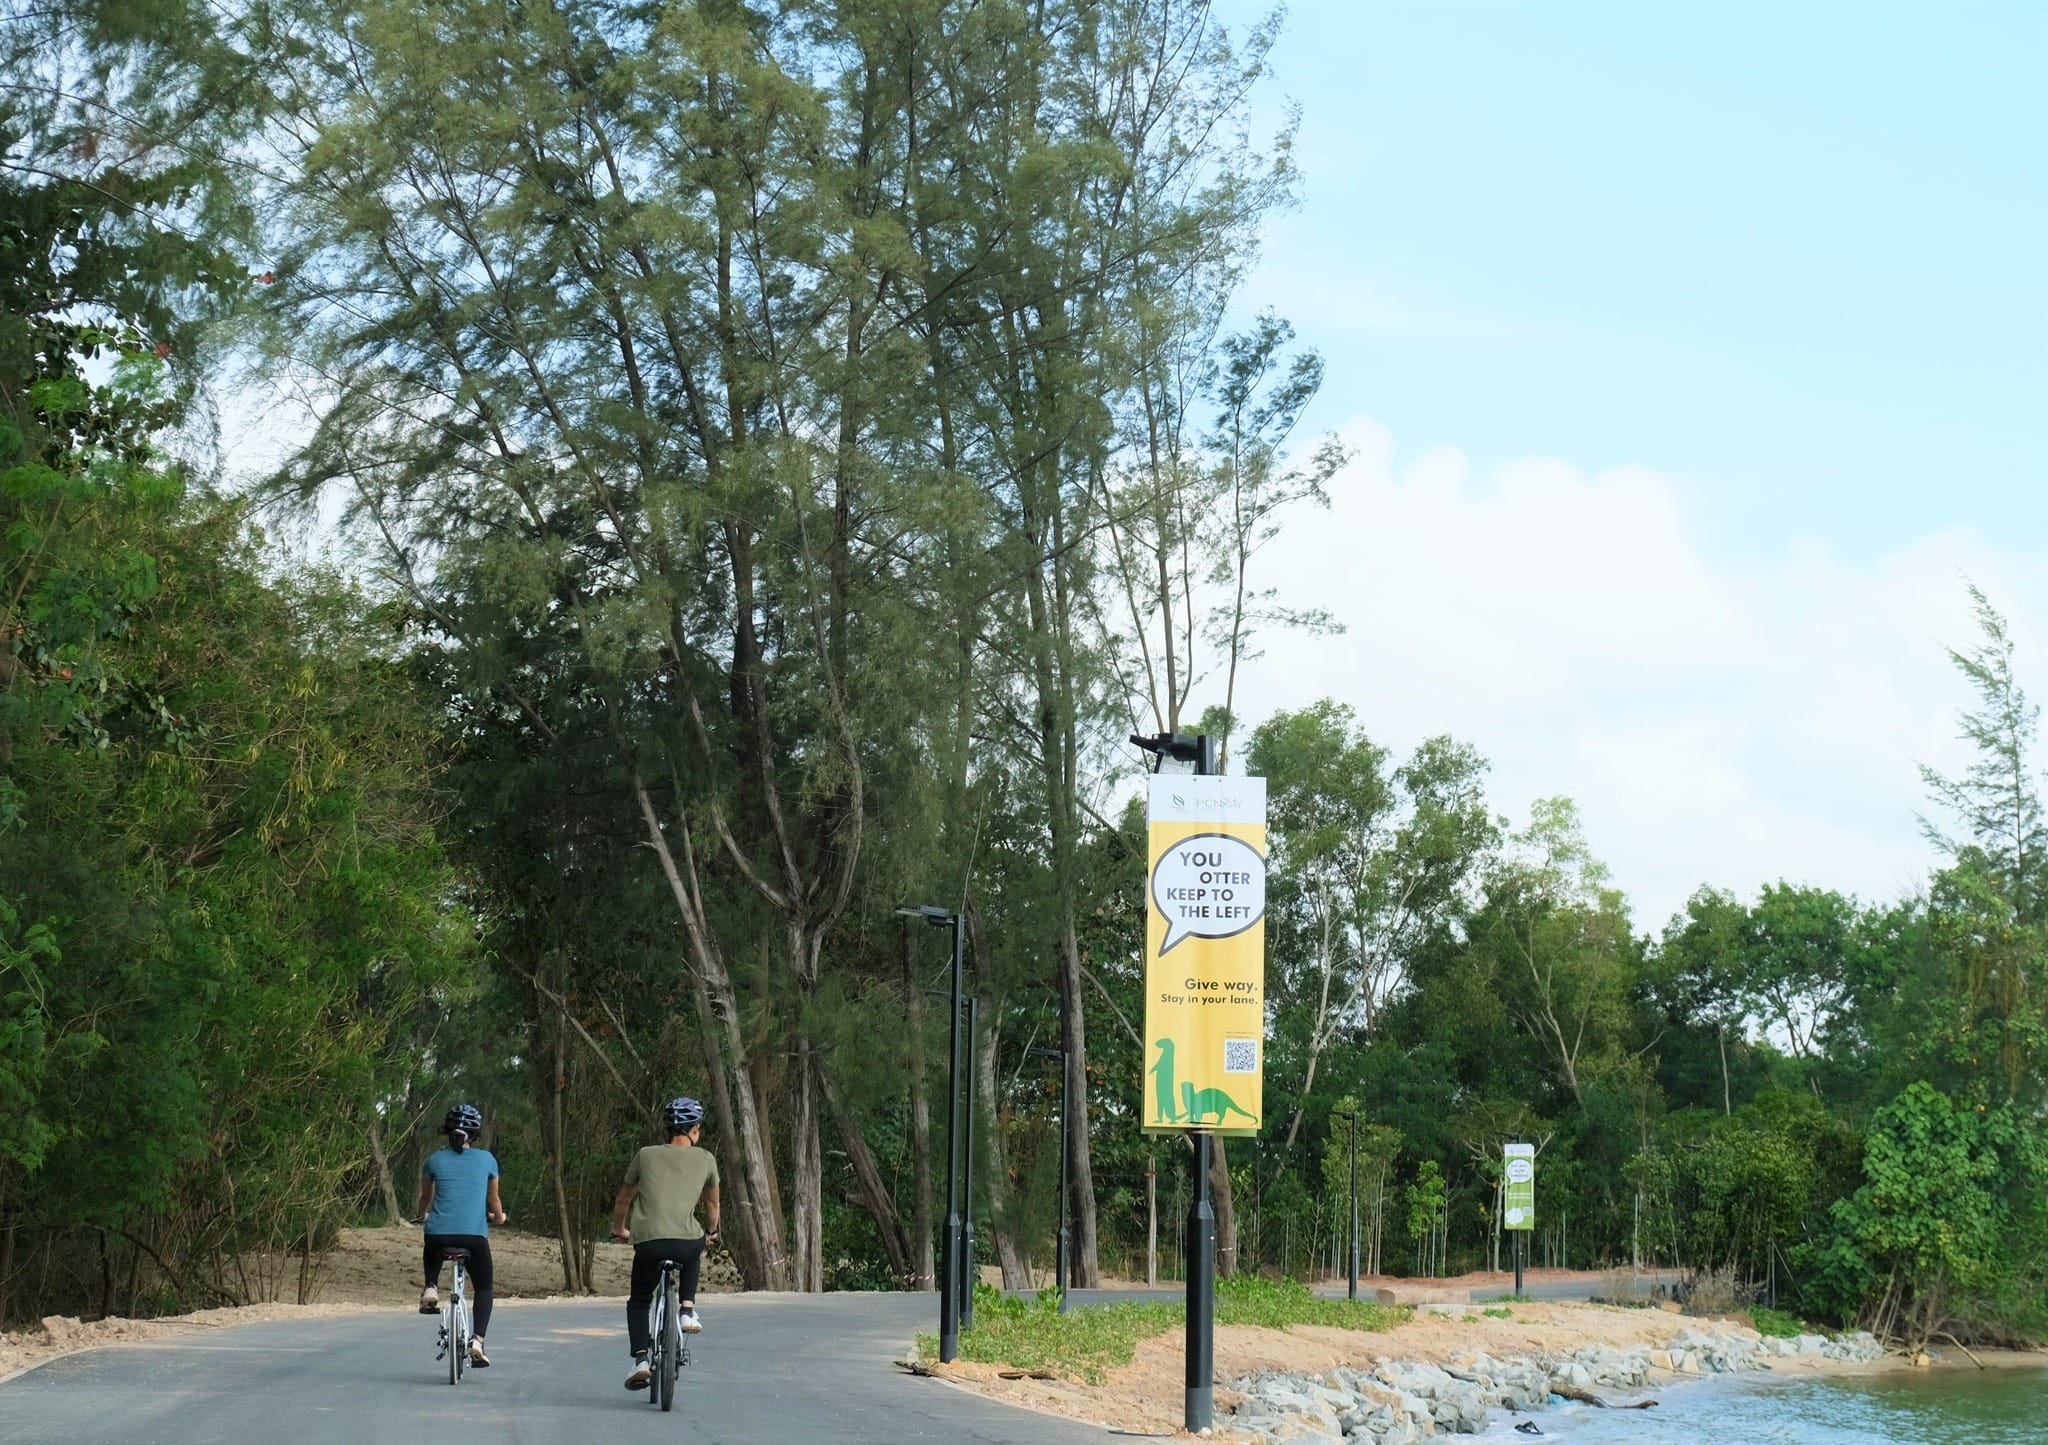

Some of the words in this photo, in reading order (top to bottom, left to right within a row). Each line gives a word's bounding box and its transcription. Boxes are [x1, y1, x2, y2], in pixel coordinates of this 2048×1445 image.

[1179, 852, 1222, 867] YOU
[1199, 871, 1251, 885] OTTER
[1166, 887, 1206, 901] KEEP
[1211, 889, 1234, 902] TO
[1179, 905, 1210, 919] THE
[1215, 905, 1251, 919] LEFT
[1184, 977, 1219, 991] Give
[1224, 980, 1258, 994] way.
[1161, 993, 1185, 1006] Stay
[1188, 994, 1199, 1004] in
[1201, 996, 1226, 1006] your
[1230, 994, 1259, 1005] lane.
